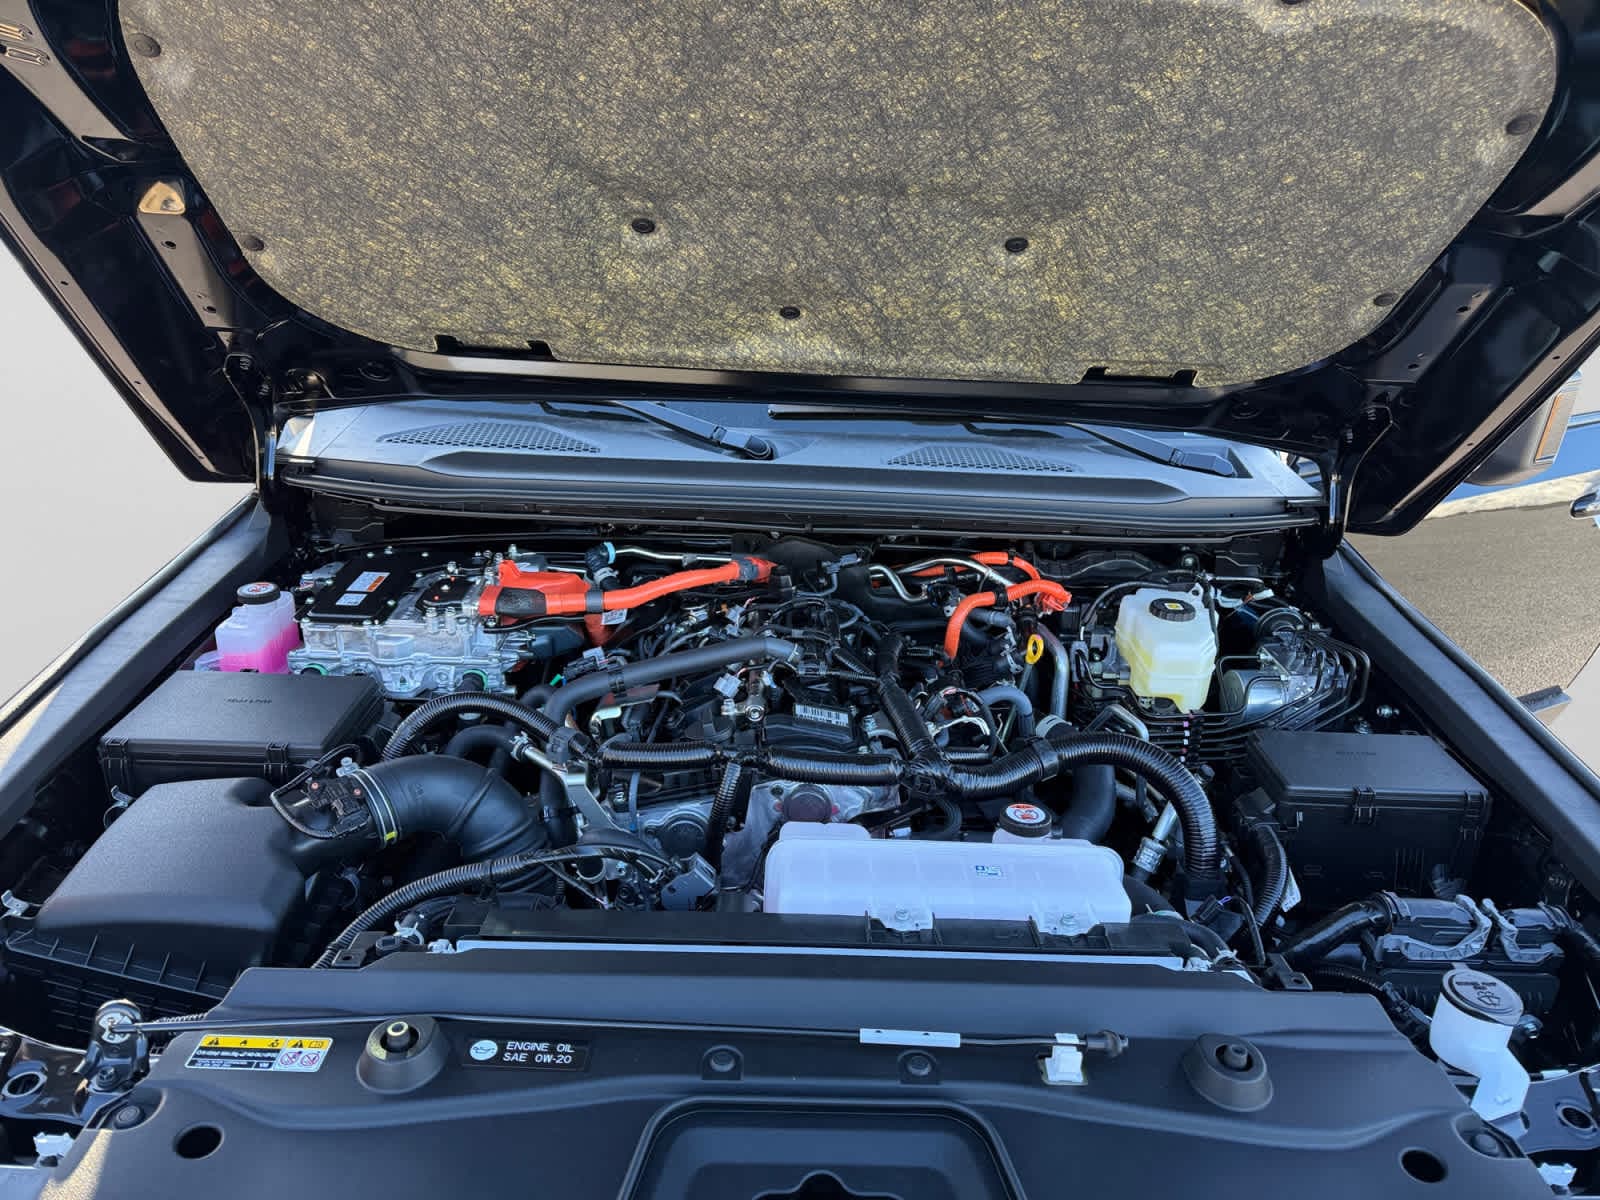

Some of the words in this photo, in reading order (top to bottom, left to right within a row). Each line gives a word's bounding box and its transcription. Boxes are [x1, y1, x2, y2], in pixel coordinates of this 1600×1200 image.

[505, 1041, 550, 1052] ENGINE
[556, 1043, 575, 1053] OIL
[503, 1052, 528, 1062] SAE
[534, 1053, 572, 1064] 0W-20
